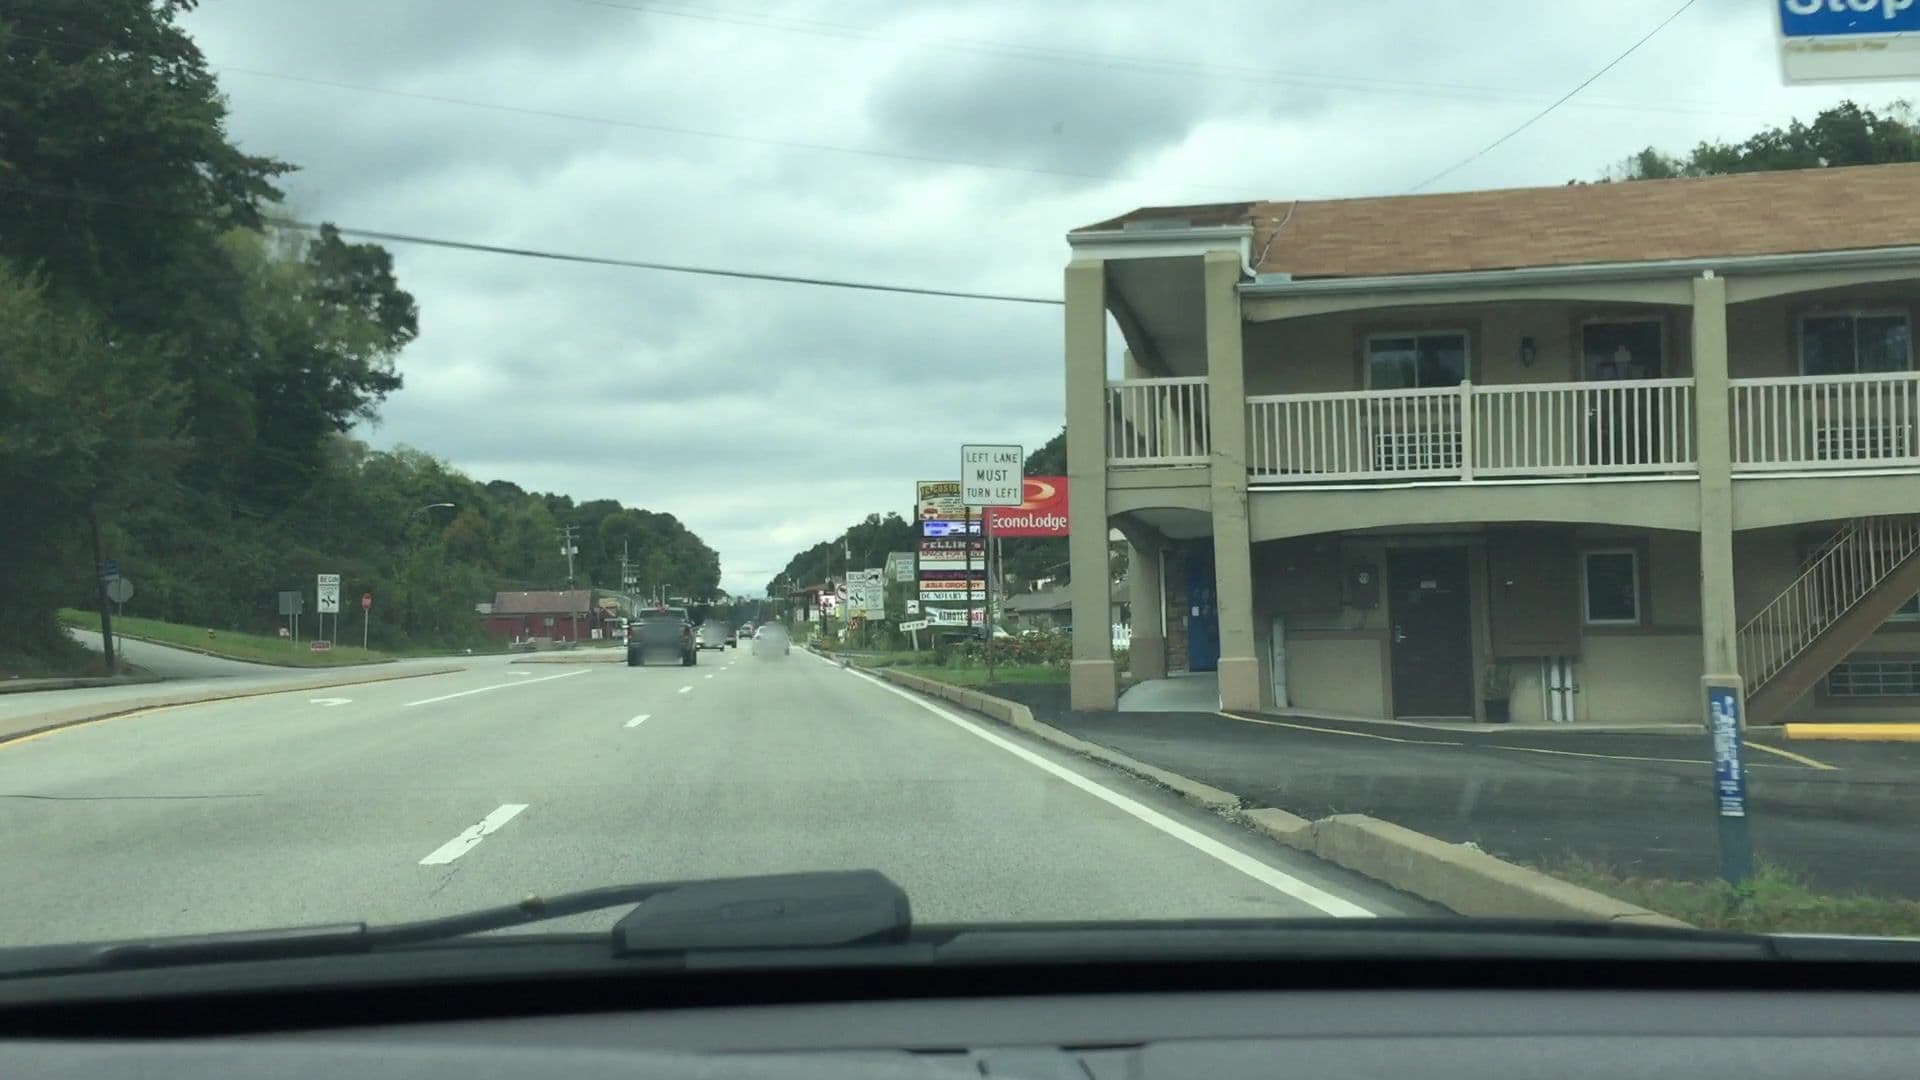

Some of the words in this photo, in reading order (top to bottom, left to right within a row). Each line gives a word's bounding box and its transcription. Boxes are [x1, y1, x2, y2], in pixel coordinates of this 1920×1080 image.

[966, 452, 988, 464] LEFT
[994, 453, 1018, 464] LANE
[976, 469, 1008, 482] MUST
[967, 487, 991, 498] TURN
[996, 487, 1018, 498] LEFT
[992, 512, 1067, 531] EconoLodge
